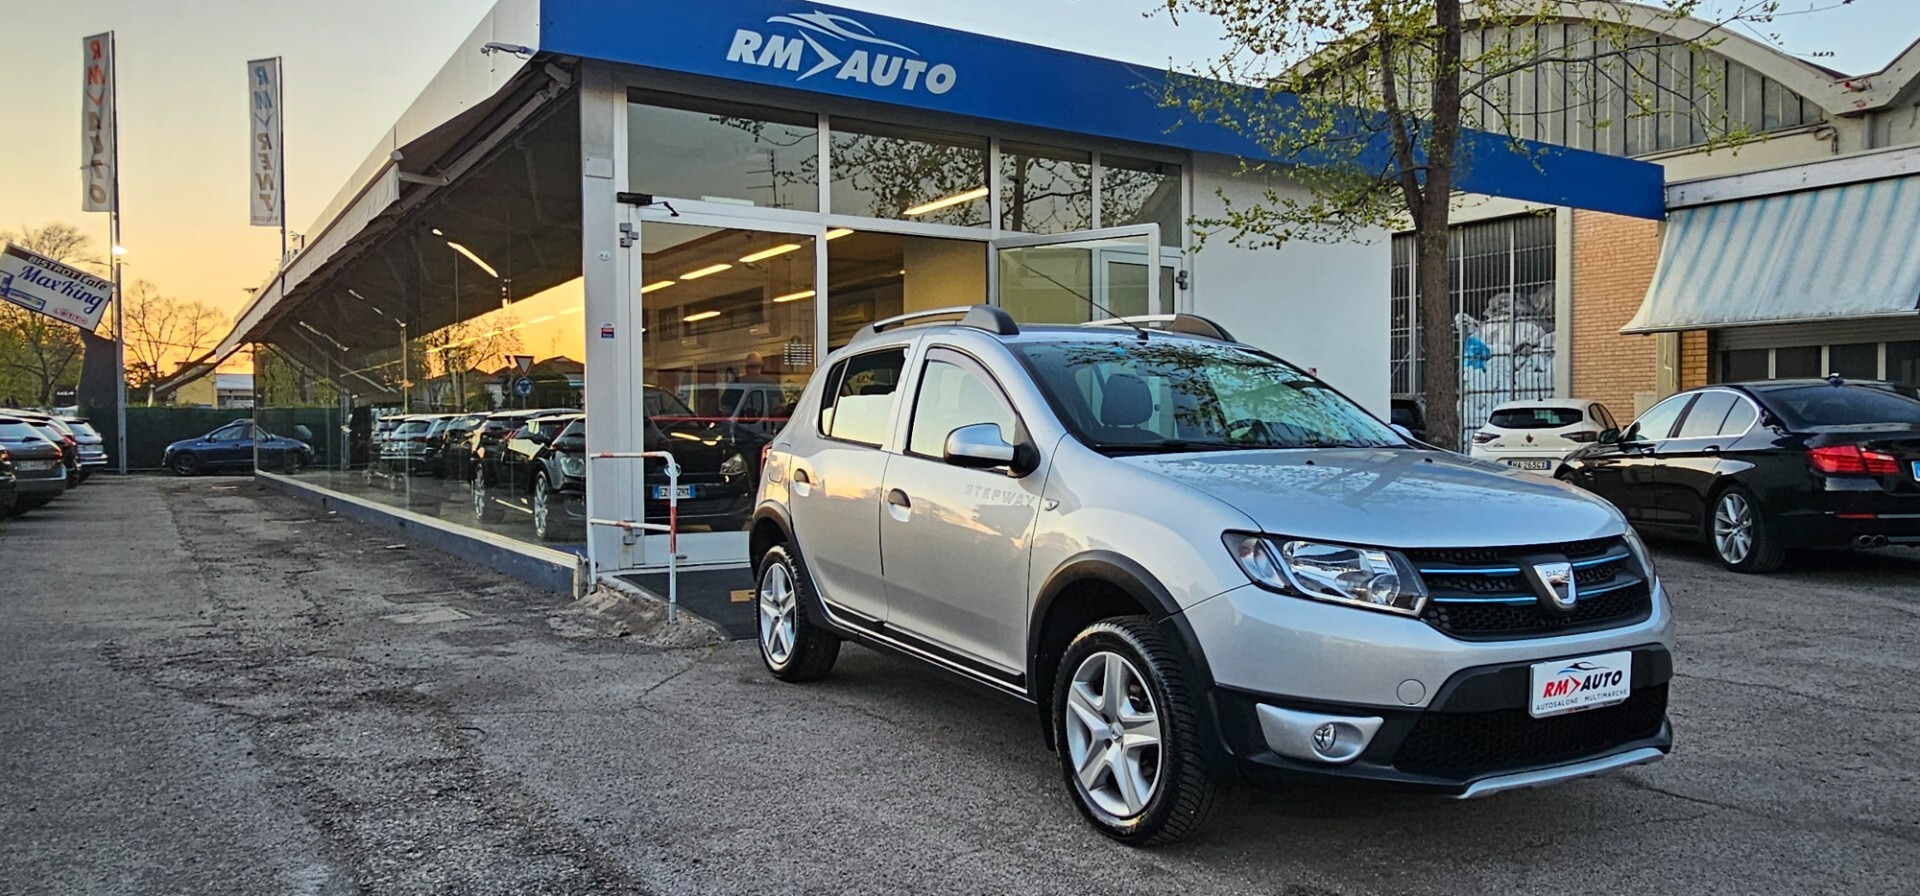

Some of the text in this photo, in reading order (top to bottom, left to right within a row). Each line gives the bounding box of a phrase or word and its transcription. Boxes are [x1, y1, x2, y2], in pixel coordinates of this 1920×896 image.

[726, 29, 957, 95] RM AUTO
[29, 255, 80, 280] BISTROT
[965, 484, 1036, 508] STEPWAY
[1542, 670, 1623, 698] RM AUTO
[1536, 697, 1579, 711] AUTOSALONE
[1584, 688, 1628, 701] MULTIMARCHE
